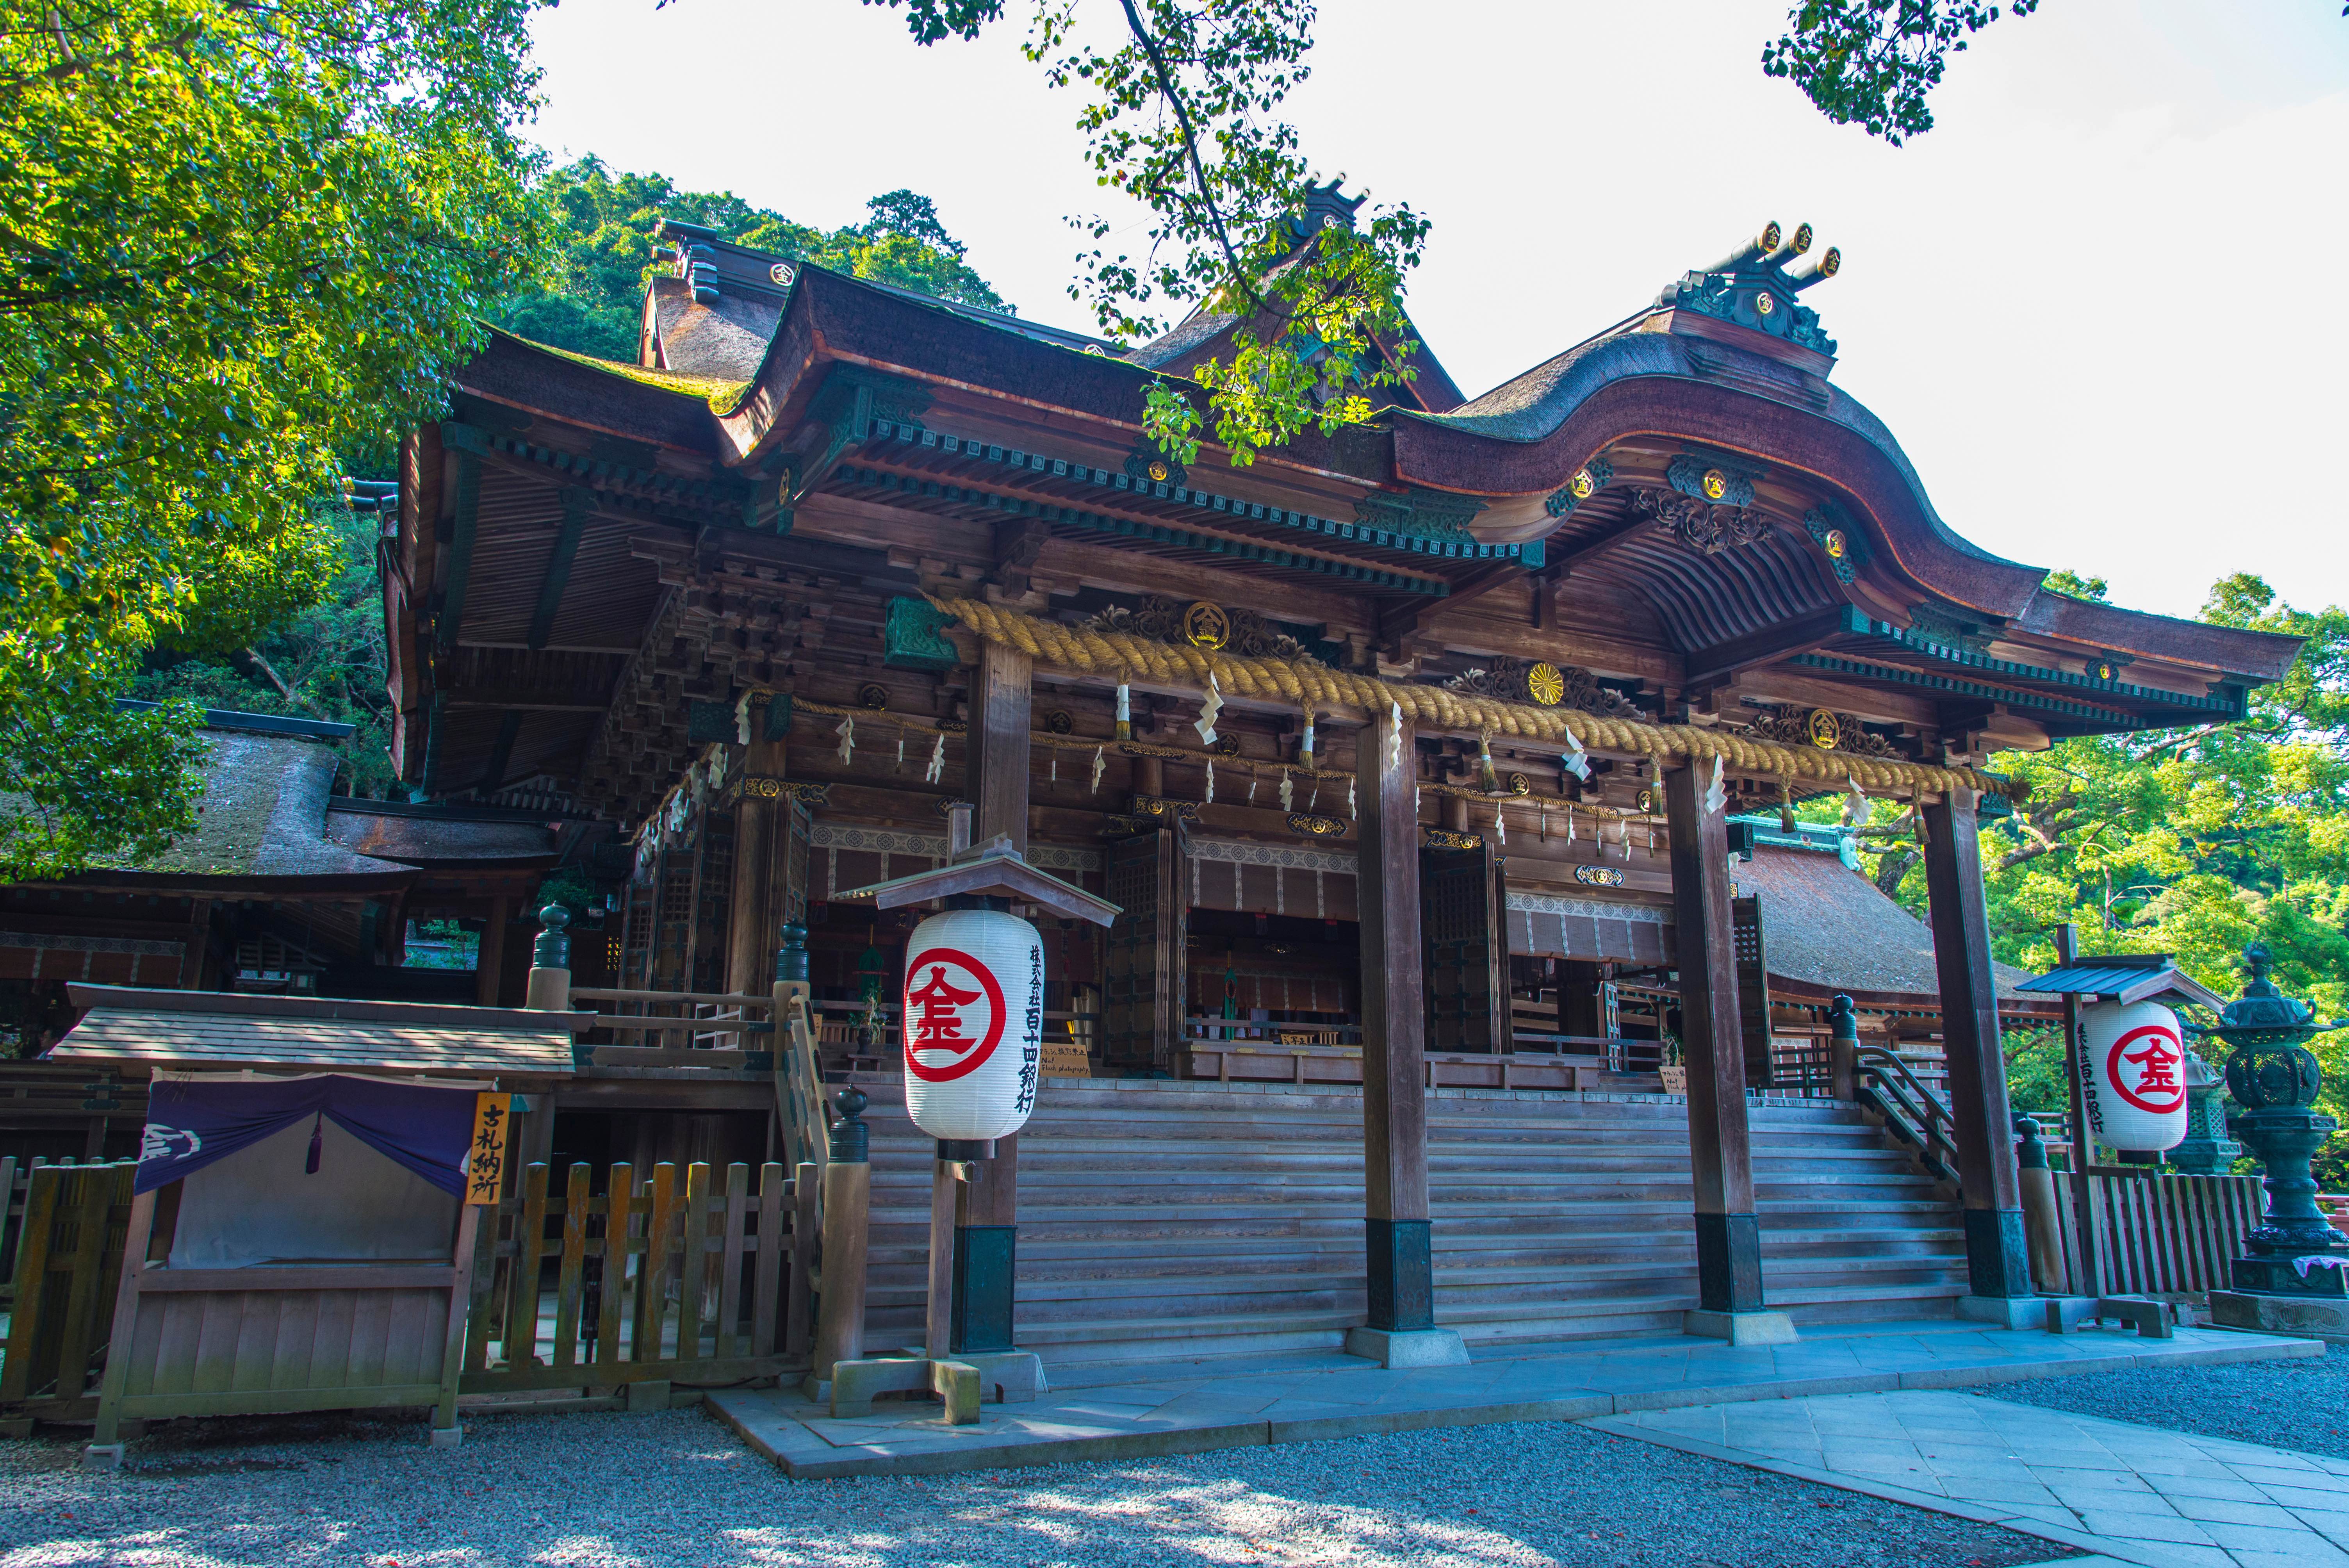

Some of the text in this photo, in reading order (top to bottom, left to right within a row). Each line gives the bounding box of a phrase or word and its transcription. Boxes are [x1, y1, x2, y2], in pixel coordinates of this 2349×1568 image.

[909, 966, 982, 1055] 金
[1014, 944, 1041, 1113] 株式会社百十四銀行
[2123, 1038, 2180, 1096] 金
[471, 1104, 504, 1202] 古札納所
